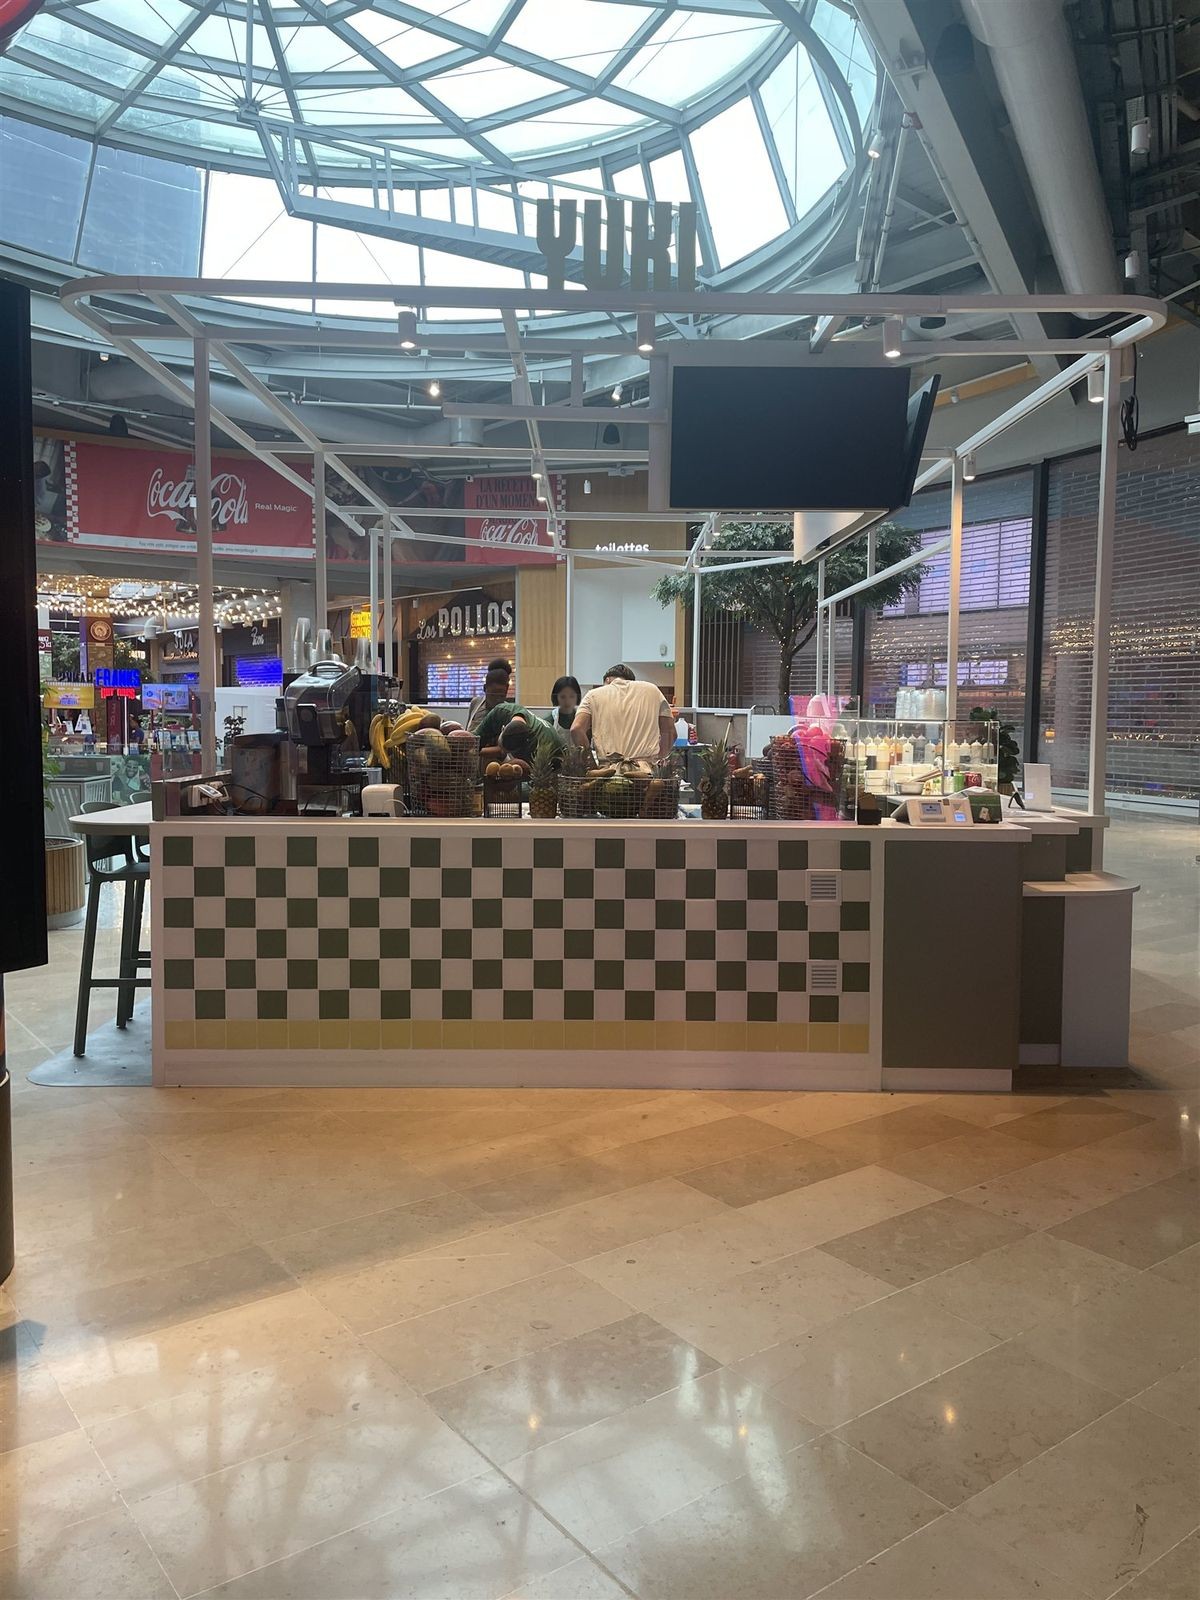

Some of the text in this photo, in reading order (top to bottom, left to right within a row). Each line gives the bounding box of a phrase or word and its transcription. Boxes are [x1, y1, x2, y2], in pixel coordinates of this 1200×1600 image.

[537, 198, 697, 291] YUKI
[147, 468, 249, 525] CocaCola
[255, 503, 297, 512] Real Magic
[416, 600, 513, 640] Los POLLOS
